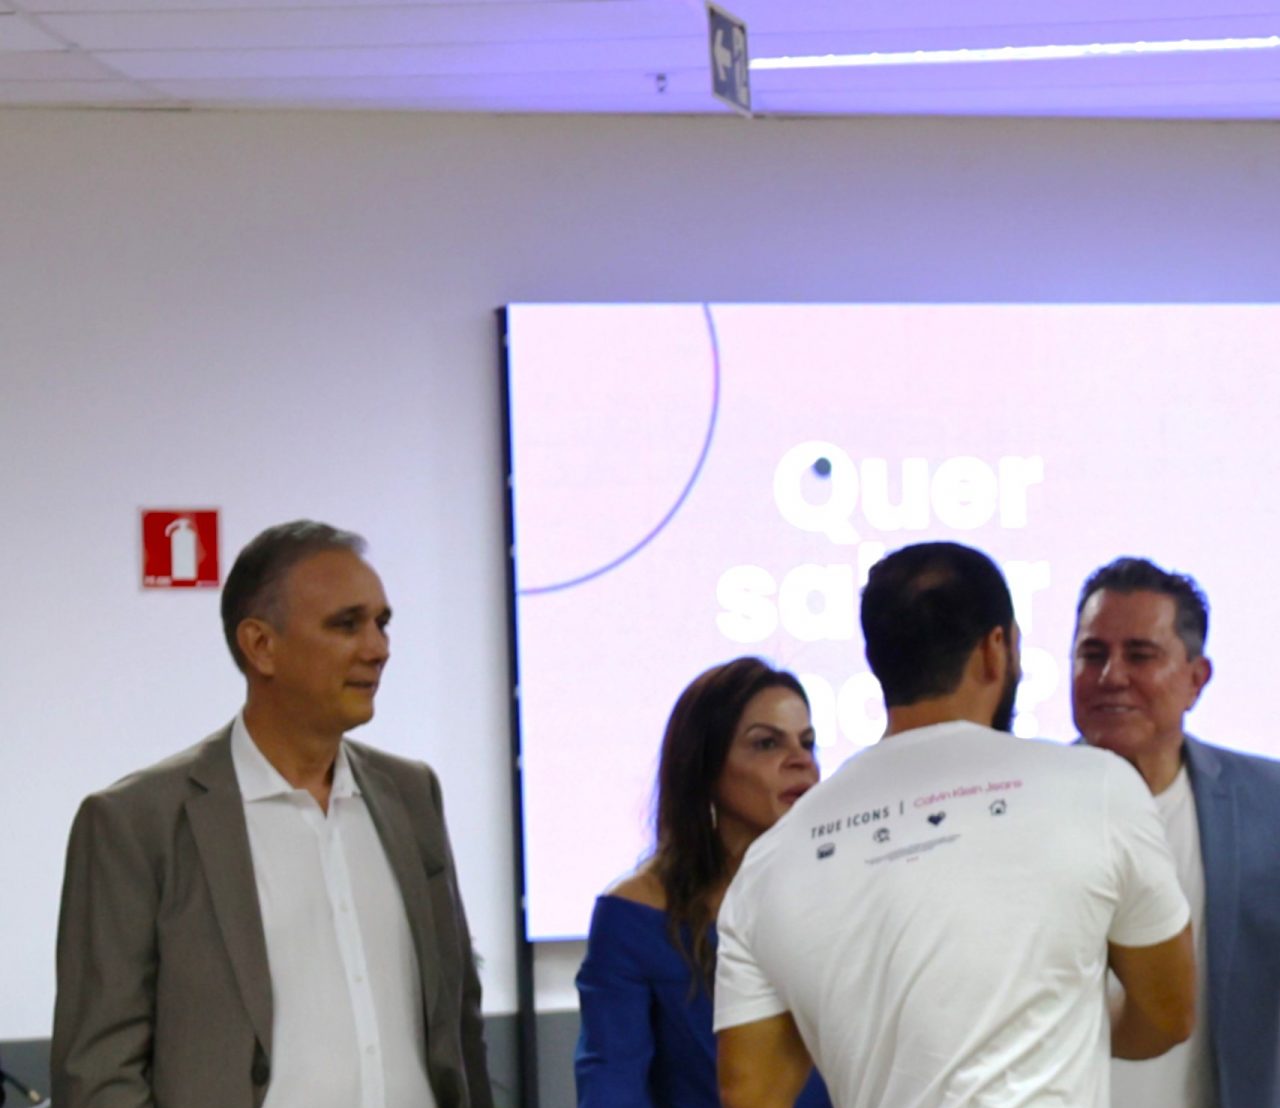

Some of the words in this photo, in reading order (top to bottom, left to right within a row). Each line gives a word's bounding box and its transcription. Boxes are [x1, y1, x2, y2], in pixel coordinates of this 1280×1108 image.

[773, 441, 1044, 544] Quer
[715, 541, 1051, 643] sar
[811, 818, 842, 839] TRUE
[847, 806, 890, 828] ICONS
[913, 790, 951, 808] Calvin
[953, 785, 983, 799] Klein
[985, 779, 1024, 793] Jeans
